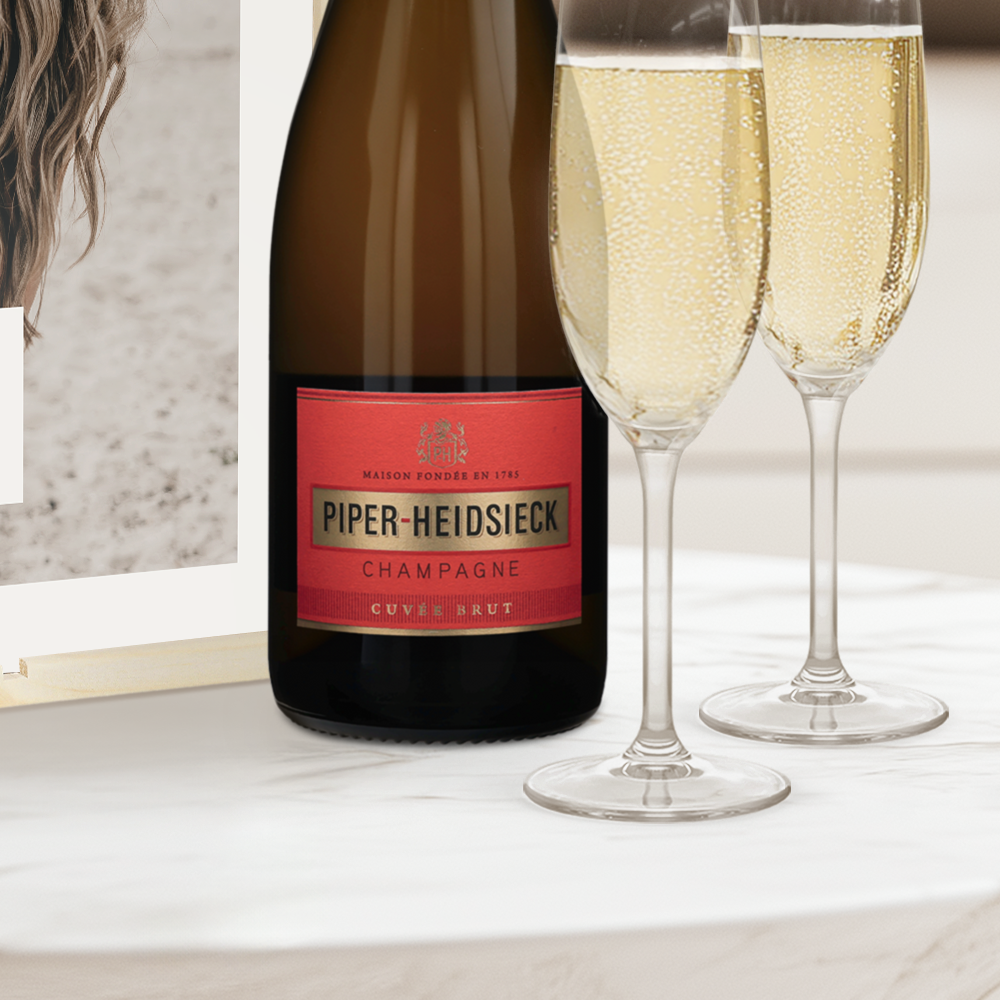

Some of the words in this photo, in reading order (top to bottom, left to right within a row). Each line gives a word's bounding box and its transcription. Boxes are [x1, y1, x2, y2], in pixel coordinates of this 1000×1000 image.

[363, 470, 411, 480] MAISON
[417, 470, 468, 480] FONDÉE
[473, 471, 489, 480] EN
[495, 470, 520, 479] 1785
[323, 499, 558, 538] PIPER-HEIDSIECK
[362, 560, 520, 579] CHAMPAGNE
[371, 602, 443, 616] CUVÉE
[457, 602, 513, 616] BRUT
